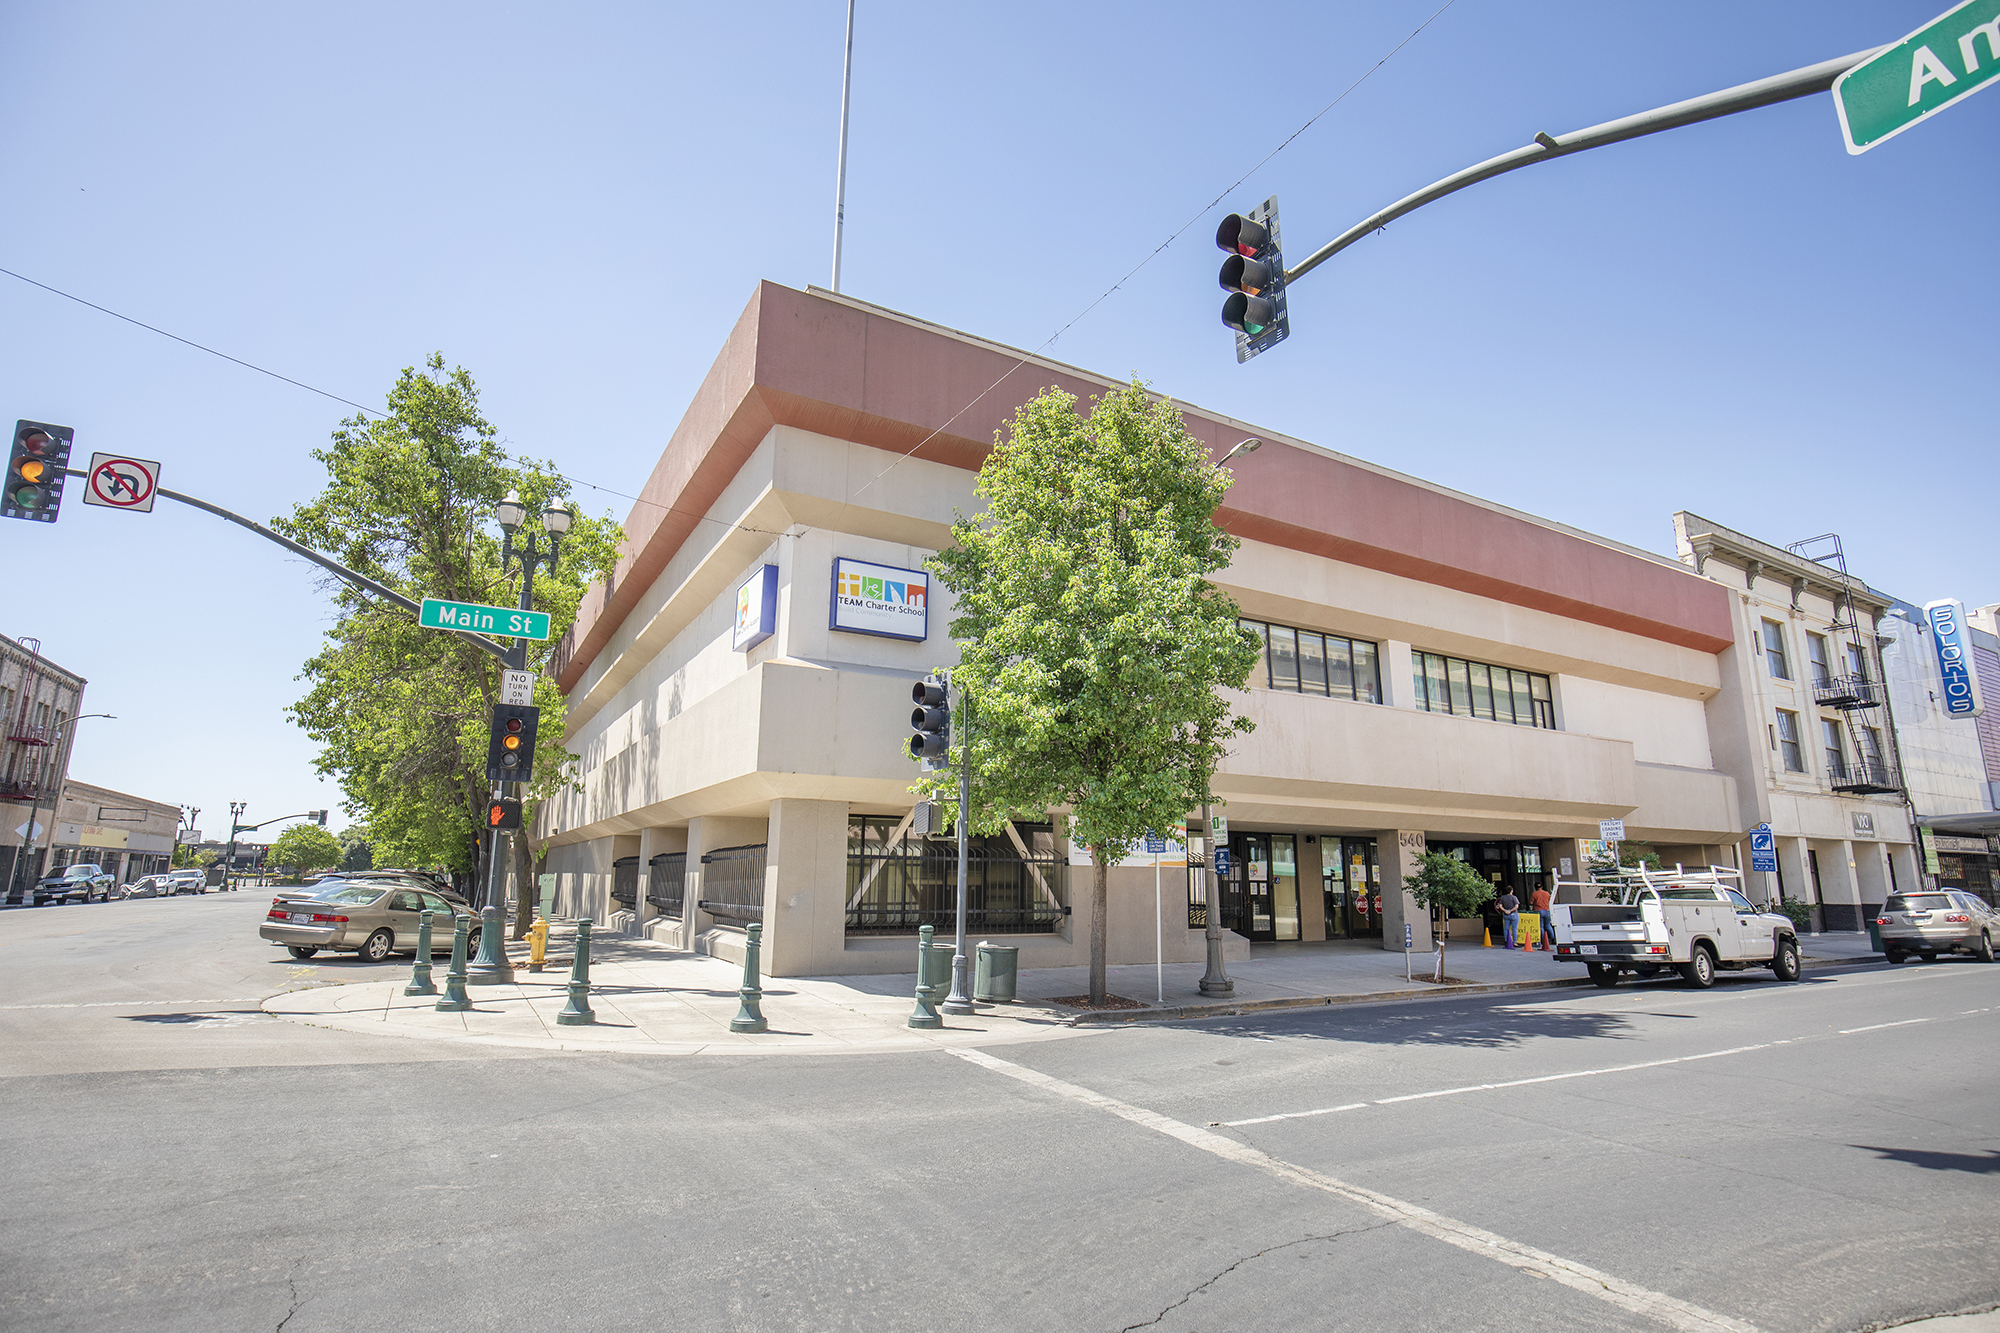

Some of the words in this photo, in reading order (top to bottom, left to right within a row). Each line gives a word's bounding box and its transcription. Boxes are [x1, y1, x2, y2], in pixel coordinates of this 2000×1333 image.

[838, 596, 863, 607] TEAM
[865, 600, 896, 612] Charter
[898, 605, 925, 616] School
[438, 606, 494, 629] Main
[508, 614, 532, 634] St
[1934, 608, 1972, 712] SOLORIO'S
[511, 674, 527, 682] NO
[1400, 832, 1424, 847] 540
